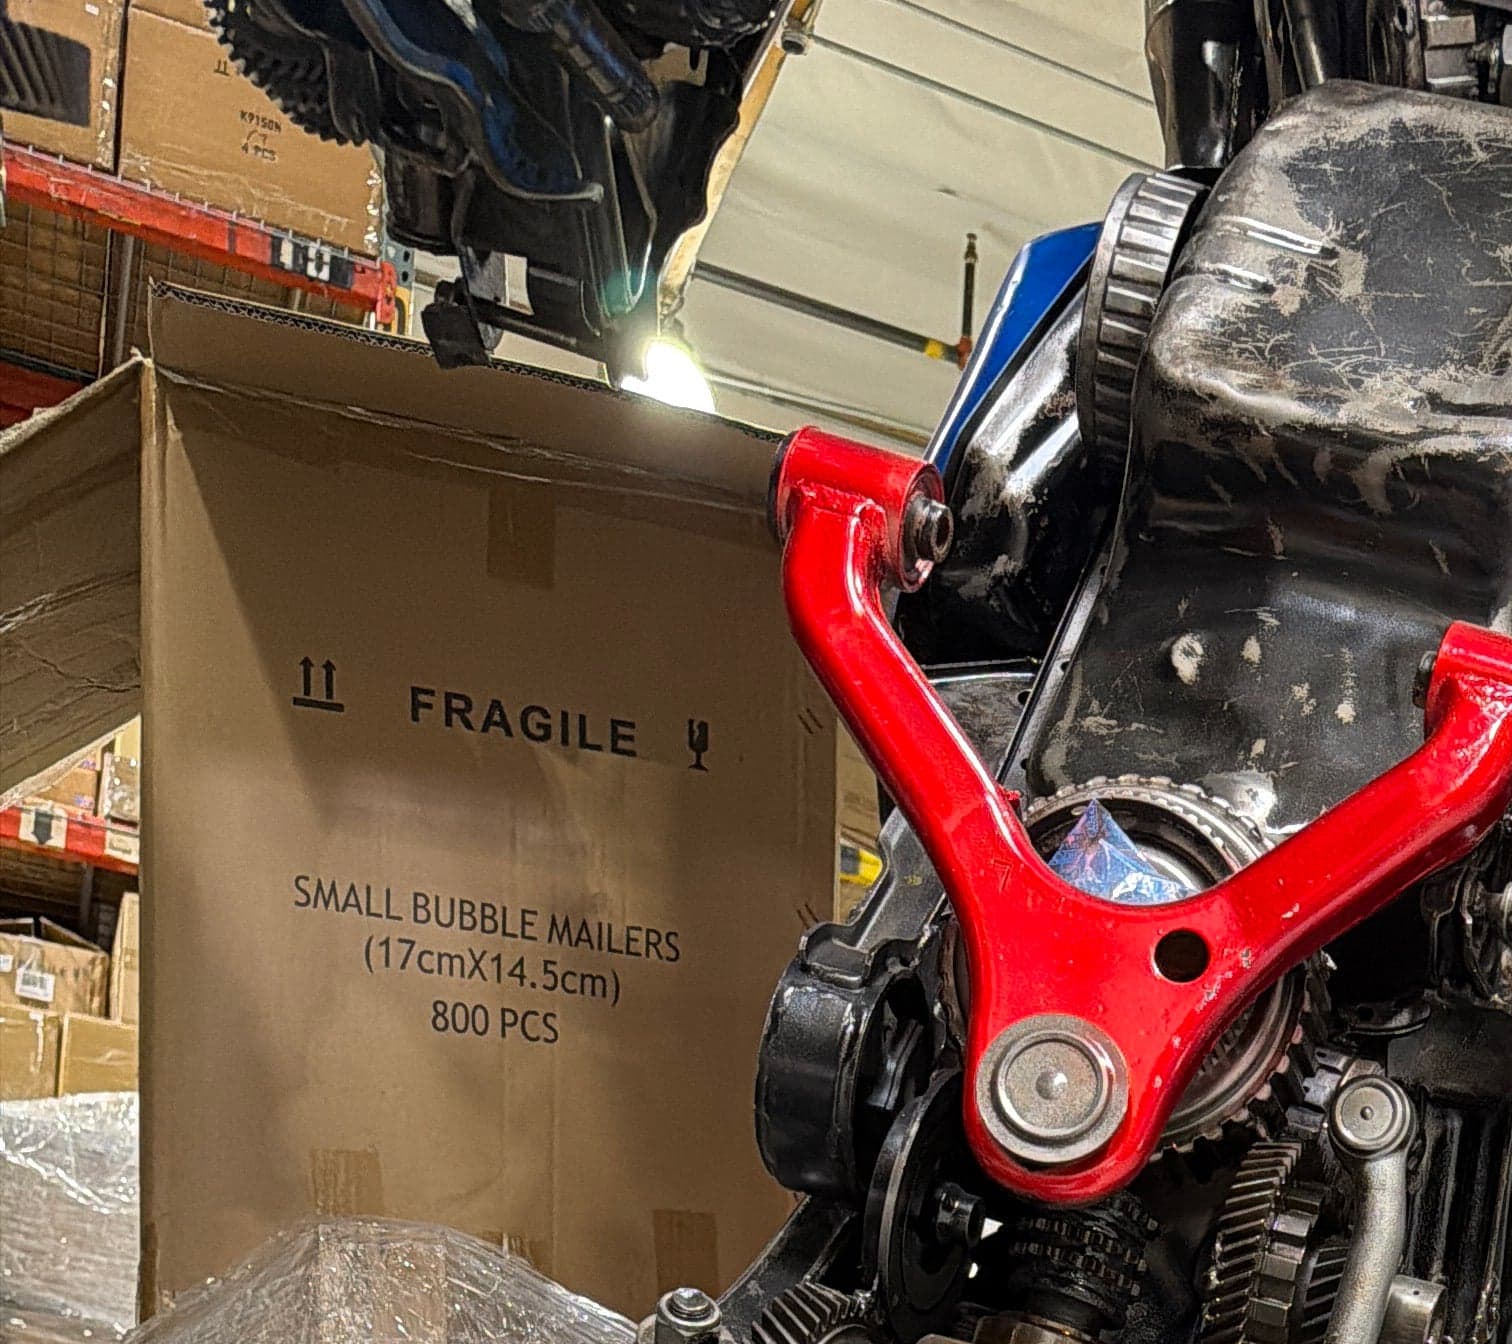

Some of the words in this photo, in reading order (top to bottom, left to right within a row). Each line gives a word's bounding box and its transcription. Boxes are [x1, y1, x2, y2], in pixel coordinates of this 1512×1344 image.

[410, 686, 637, 757] FRAGILE
[294, 875, 403, 921] SMALL
[413, 893, 539, 940] BUBBLE
[548, 914, 681, 963] MAILERS
[364, 936, 621, 1006] (17cmX14.5cm)
[431, 1001, 489, 1037] 800
[500, 1008, 559, 1044] PCS
